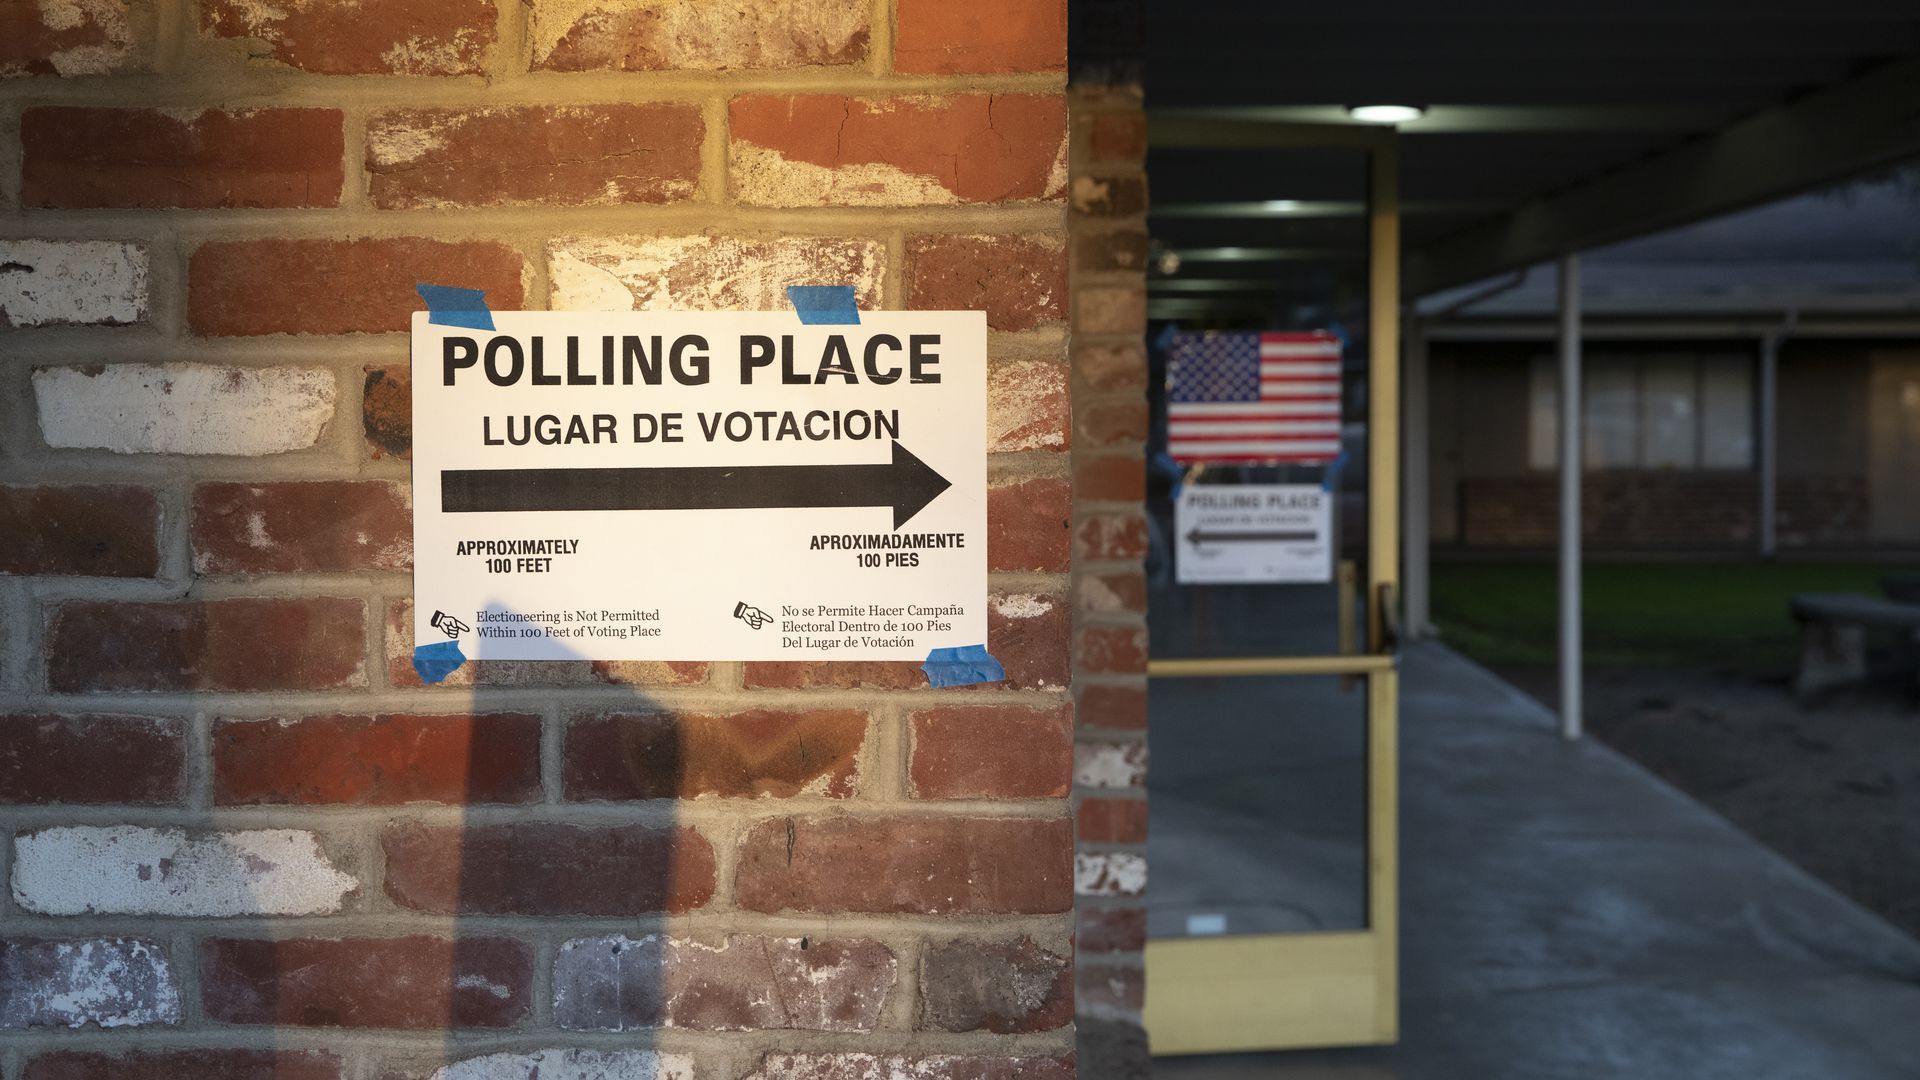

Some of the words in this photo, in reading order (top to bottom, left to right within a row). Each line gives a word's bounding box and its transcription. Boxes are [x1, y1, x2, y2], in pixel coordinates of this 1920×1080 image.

[443, 335, 709, 387] POLLING
[740, 334, 941, 385] PLACE
[484, 414, 618, 446] LUGAR
[633, 413, 683, 443] DE
[697, 410, 899, 442] VOTACION
[457, 539, 579, 555] APPROXIMATELY
[810, 533, 964, 550] APROXIMADAMENTE
[486, 559, 511, 573] 100
[517, 558, 552, 573] FEET
[857, 553, 880, 567] 100
[886, 552, 919, 567] PIES
[477, 610, 560, 624] Electioneering
[564, 611, 573, 621] is
[576, 611, 597, 621] Not
[601, 609, 659, 621] Permitted
[782, 606, 799, 616] No
[818, 605, 865, 616] Permite
[869, 605, 904, 616] Hacer
[908, 604, 964, 618] Campaña
[477, 626, 516, 638] Within
[520, 629, 541, 637] 100
[545, 627, 570, 637] Feet
[574, 626, 585, 637] of
[587, 626, 627, 639] Voting
[631, 625, 660, 636] Place
[783, 621, 834, 632] Electoral
[839, 621, 880, 631] Dentro
[884, 620, 897, 631] de
[902, 623, 923, 631] 100
[927, 620, 951, 631] Pies
[783, 636, 802, 648] Del
[806, 637, 841, 650] Lugar
[844, 636, 858, 647] de
[861, 636, 914, 647] Votación
